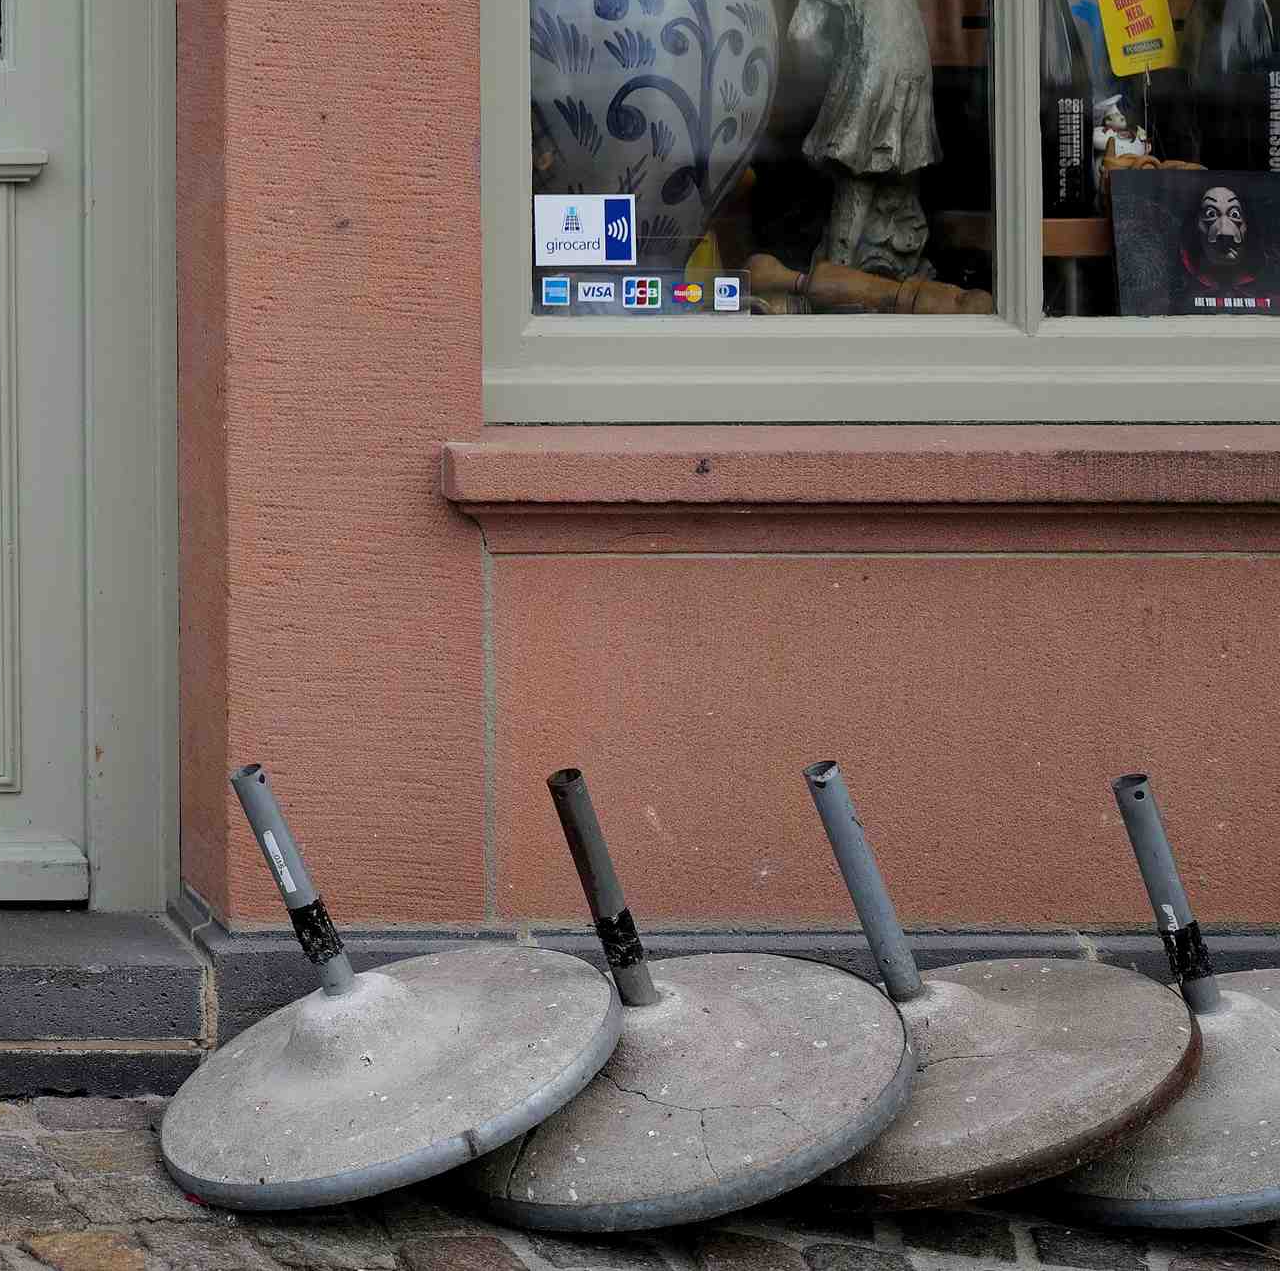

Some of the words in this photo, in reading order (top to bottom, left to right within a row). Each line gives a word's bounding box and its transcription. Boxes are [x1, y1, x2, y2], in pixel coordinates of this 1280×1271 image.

[546, 238, 601, 255] girocard
[582, 286, 613, 298] VISA
[625, 286, 659, 299] JCB
